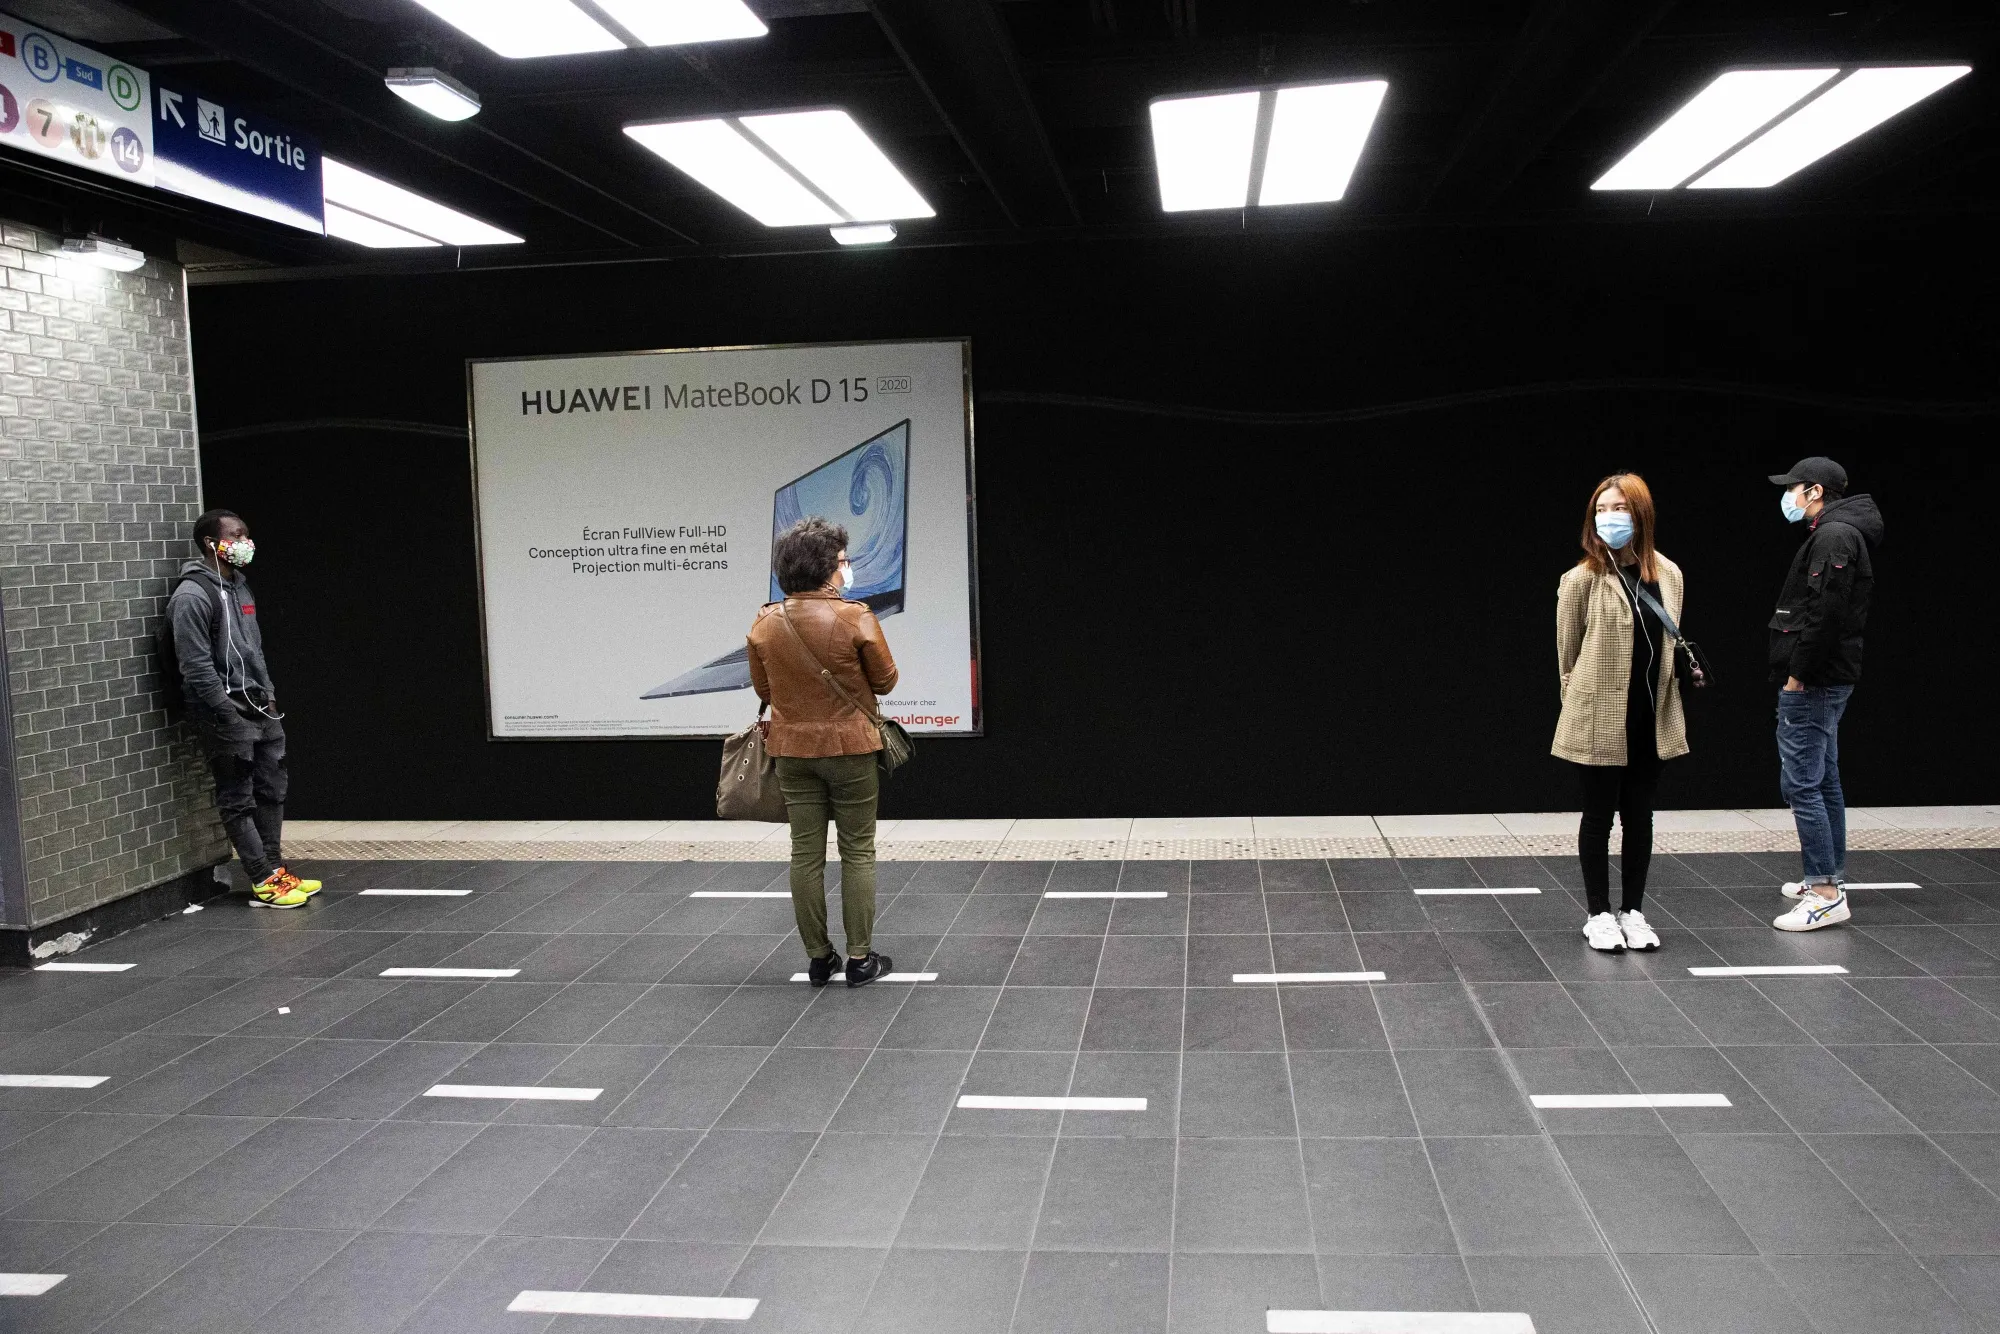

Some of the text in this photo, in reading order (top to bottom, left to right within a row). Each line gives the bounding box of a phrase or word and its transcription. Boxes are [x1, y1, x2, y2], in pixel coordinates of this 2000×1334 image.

[33, 44, 132, 99] B Sud D
[37, 108, 52, 137] 7
[114, 135, 140, 166] 14
[234, 117, 306, 171] Sortie
[521, 377, 909, 416] HUAWEI MateBook D 15 2020
[582, 525, 727, 541] Écran FullView Full-HD
[528, 541, 728, 561] Conception ultra fine en métal
[572, 558, 729, 577] Projection multi-écrans
[890, 714, 960, 726] oulanger
